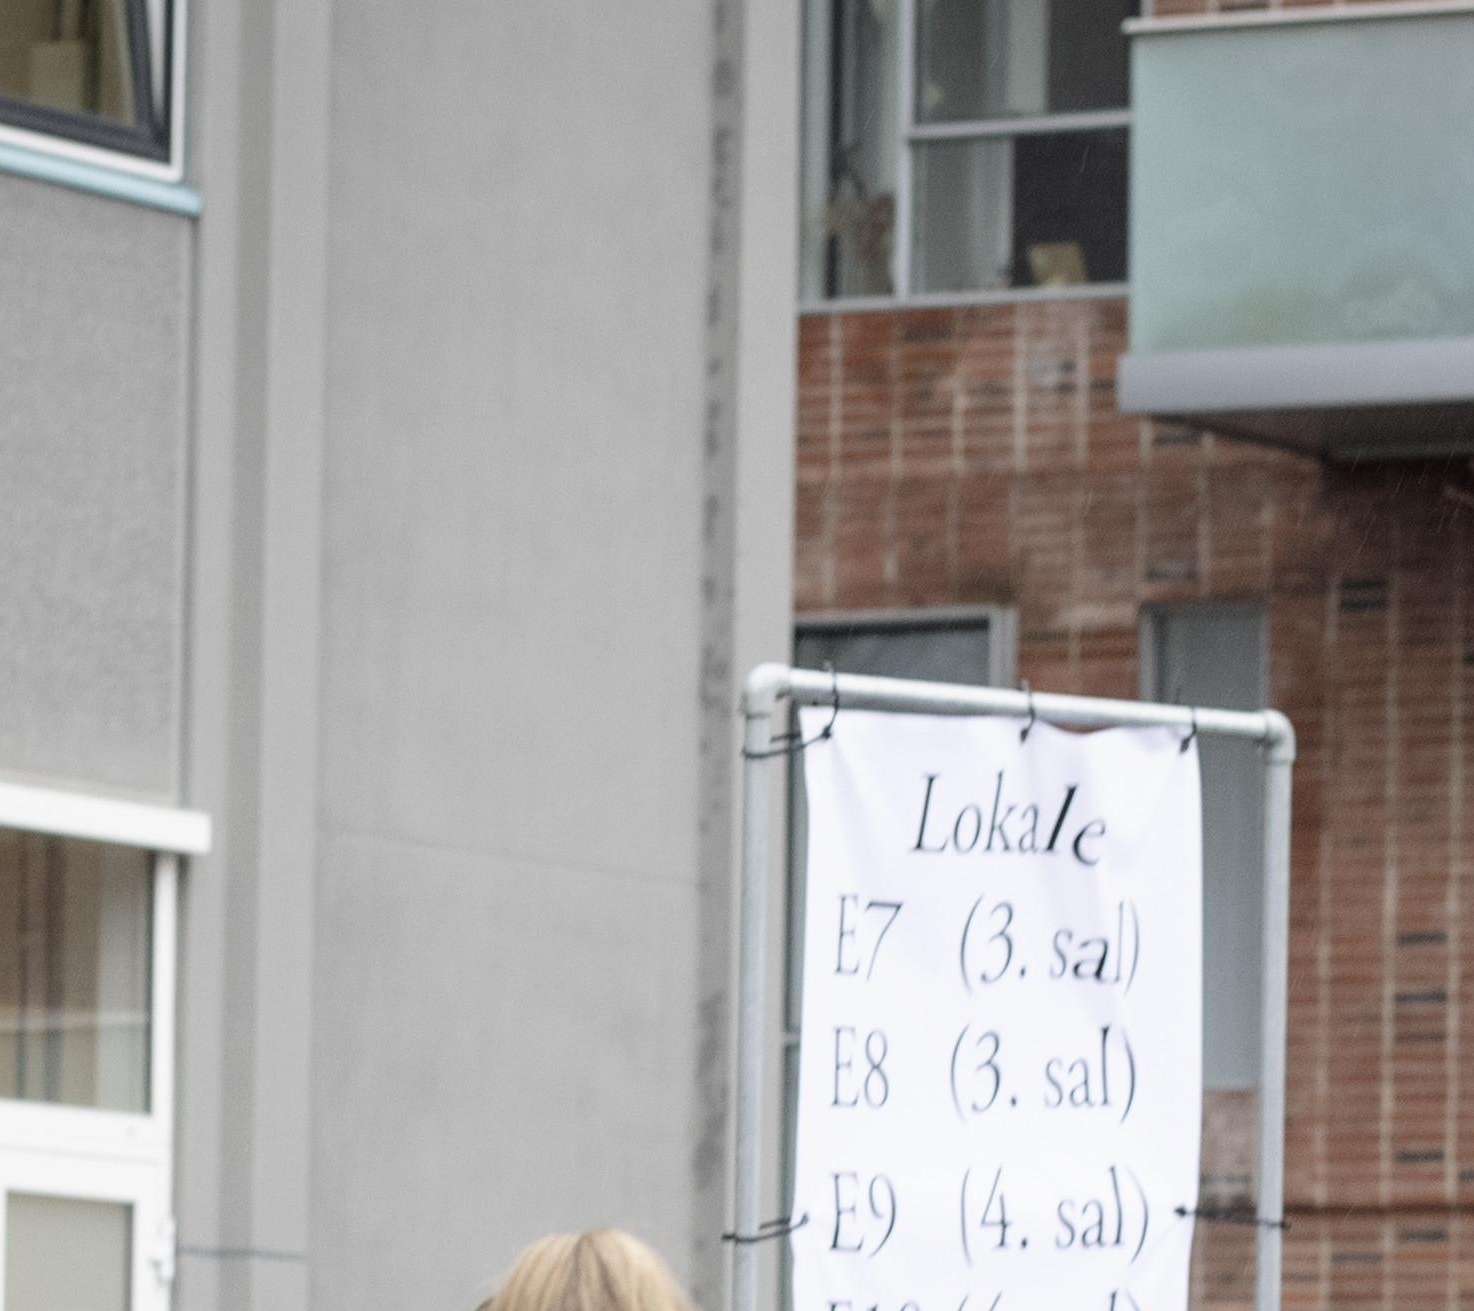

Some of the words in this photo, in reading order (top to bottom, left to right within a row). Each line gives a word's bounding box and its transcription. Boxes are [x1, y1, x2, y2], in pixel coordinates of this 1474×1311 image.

[909, 768, 1106, 867] Lokale
[834, 893, 903, 982] E7
[960, 892, 1026, 996] (3.
[1049, 897, 1139, 998] sal)
[830, 1025, 889, 1109] E8
[950, 1022, 1017, 1124] (3.
[1044, 1023, 1136, 1125] sal)
[829, 1170, 896, 1260] E9
[960, 1165, 1028, 1267] (4.
[1055, 1164, 1149, 1265] sal)
